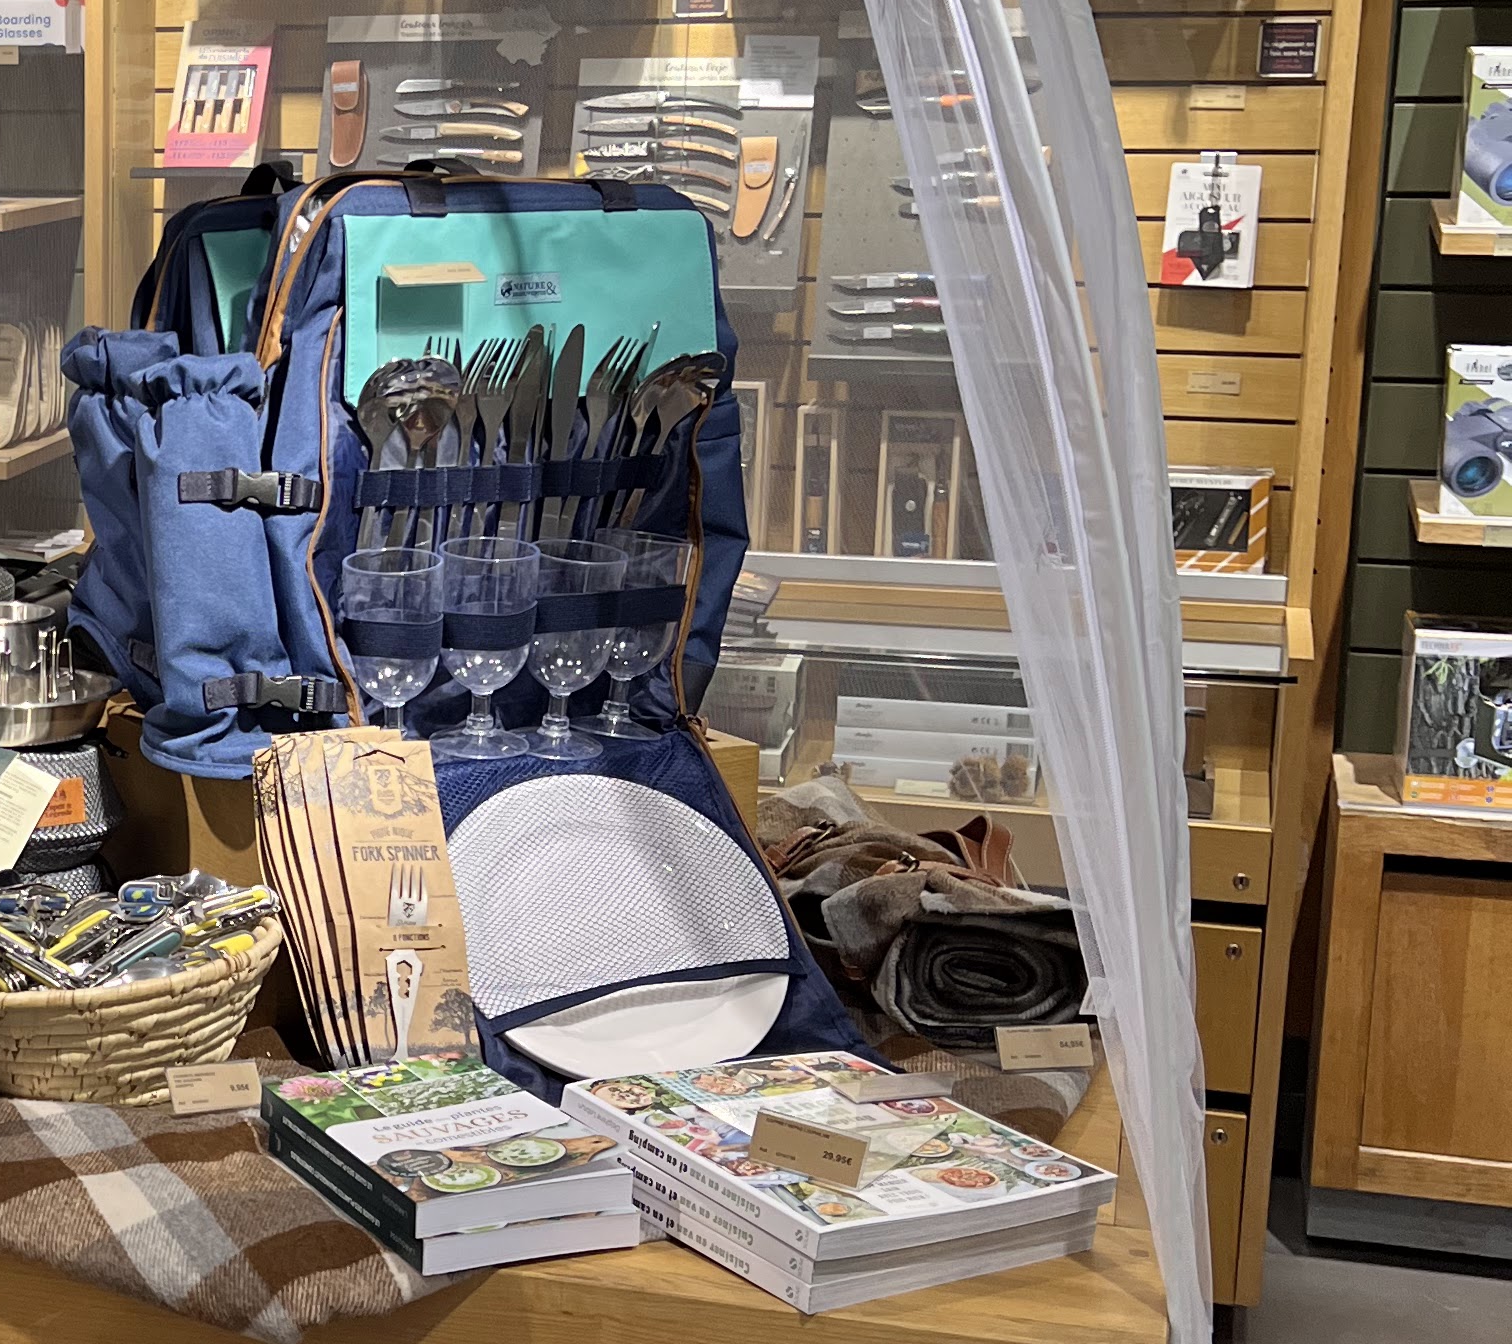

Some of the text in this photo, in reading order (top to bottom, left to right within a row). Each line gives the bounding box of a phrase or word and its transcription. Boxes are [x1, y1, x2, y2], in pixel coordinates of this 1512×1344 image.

[513, 282, 545, 290] NATURE
[546, 281, 558, 296] &
[352, 845, 441, 862] FORK SPINNER
[372, 1109, 529, 1144] SAUVAGES
[373, 1105, 503, 1133] Le guide plantes
[425, 1124, 513, 1145] comestibles
[628, 1129, 665, 1162] camping
[666, 1155, 677, 1167] en
[690, 1167, 706, 1186] van
[655, 1182, 666, 1195] en
[708, 1180, 719, 1192] en
[679, 1195, 697, 1213] van
[720, 1186, 761, 1219] Cuisiner
[652, 1209, 663, 1222] en
[699, 1208, 710, 1220] en
[676, 1223, 694, 1240] van
[713, 1214, 754, 1247] Cuisiner
[696, 1235, 707, 1247] en
[709, 1241, 750, 1274] Cuisiner
